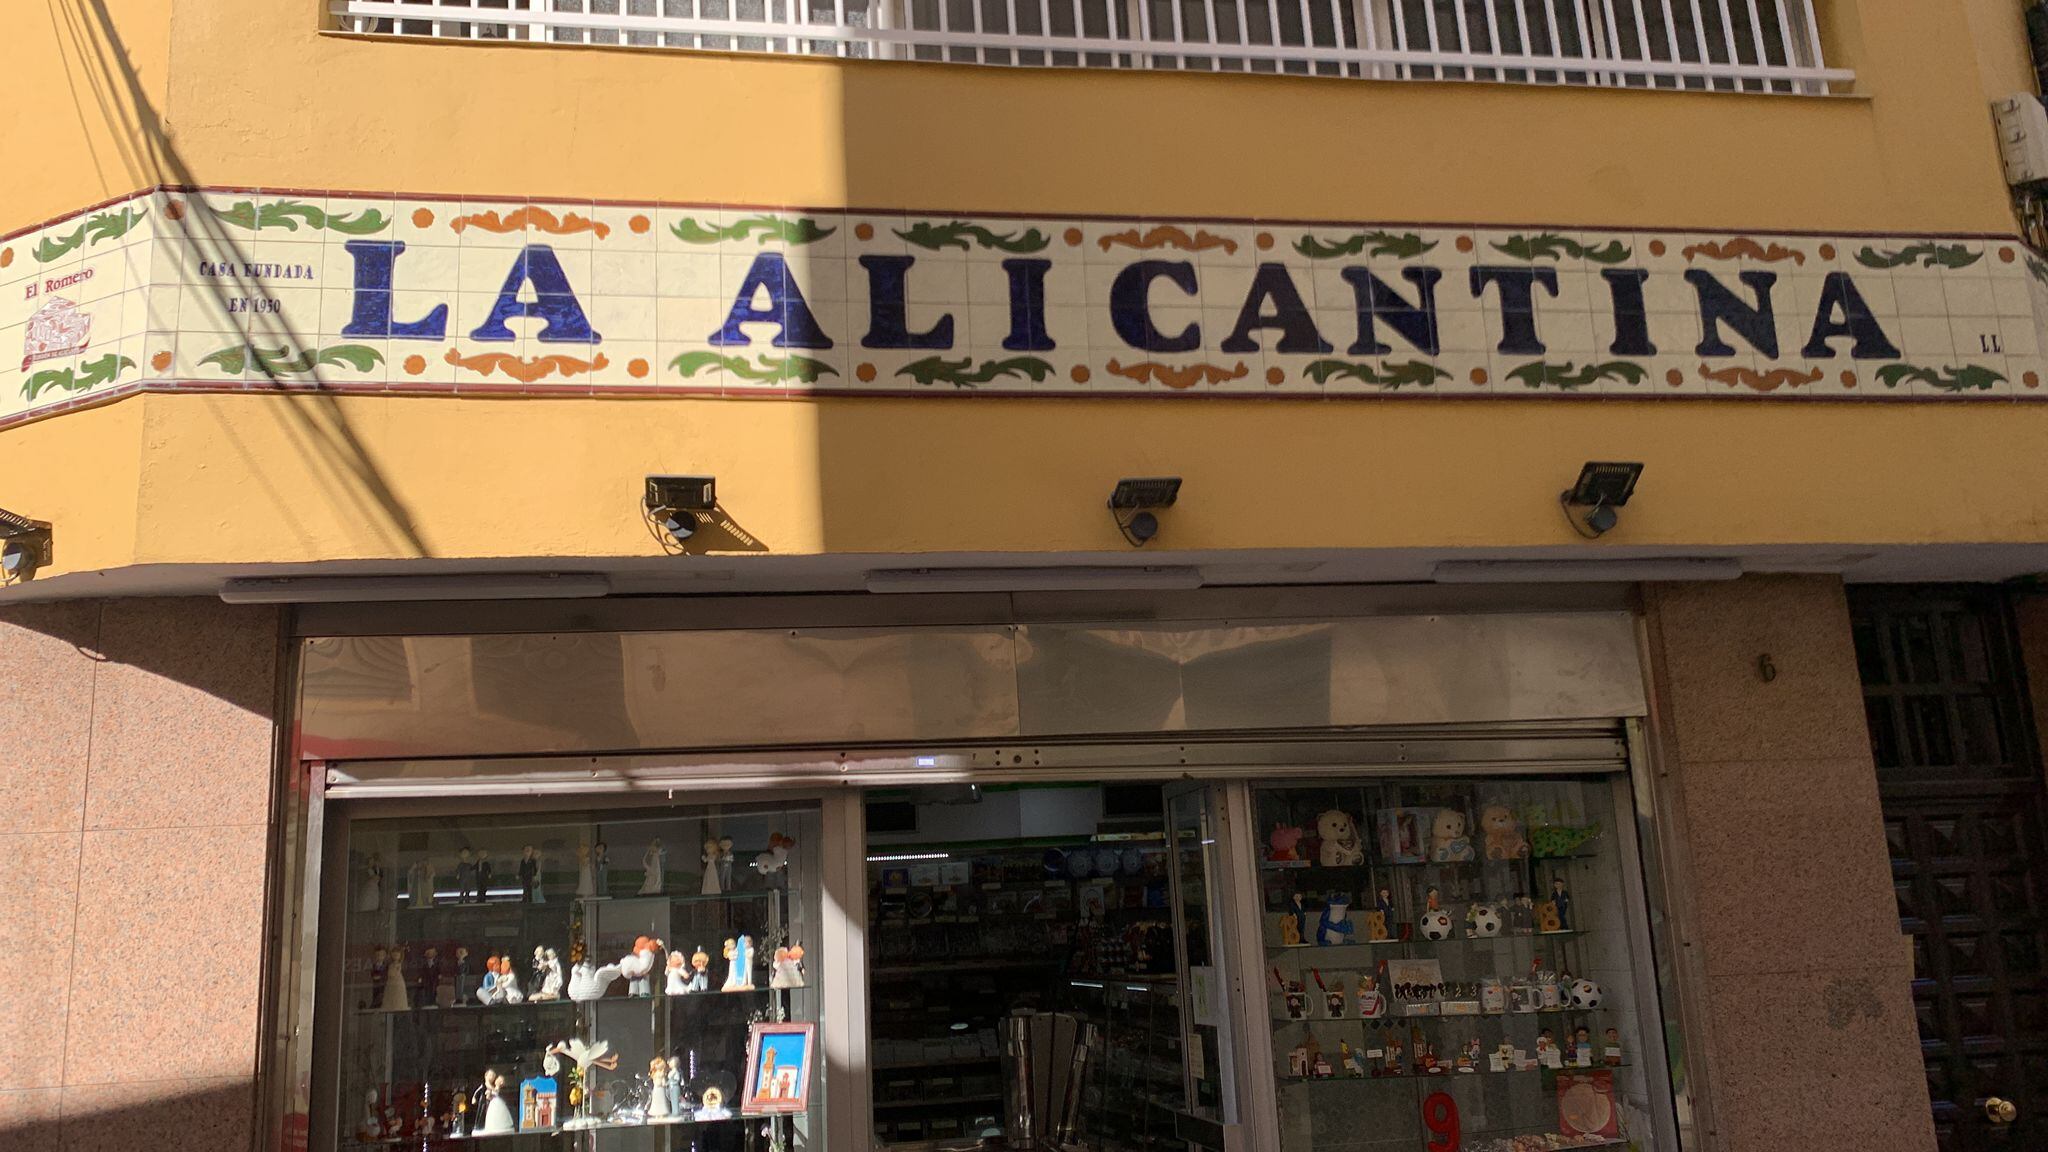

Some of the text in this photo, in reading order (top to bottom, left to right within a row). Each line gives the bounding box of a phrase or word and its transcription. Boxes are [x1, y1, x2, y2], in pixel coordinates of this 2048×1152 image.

[26, 269, 94, 299] El Romero
[200, 261, 314, 280] CASA FUNDADA
[228, 297, 281, 314] EN 1950
[341, 240, 1901, 360] LA ALICANTINA
[1759, 652, 1777, 683] 6
[1423, 1091, 1460, 1152] 9
